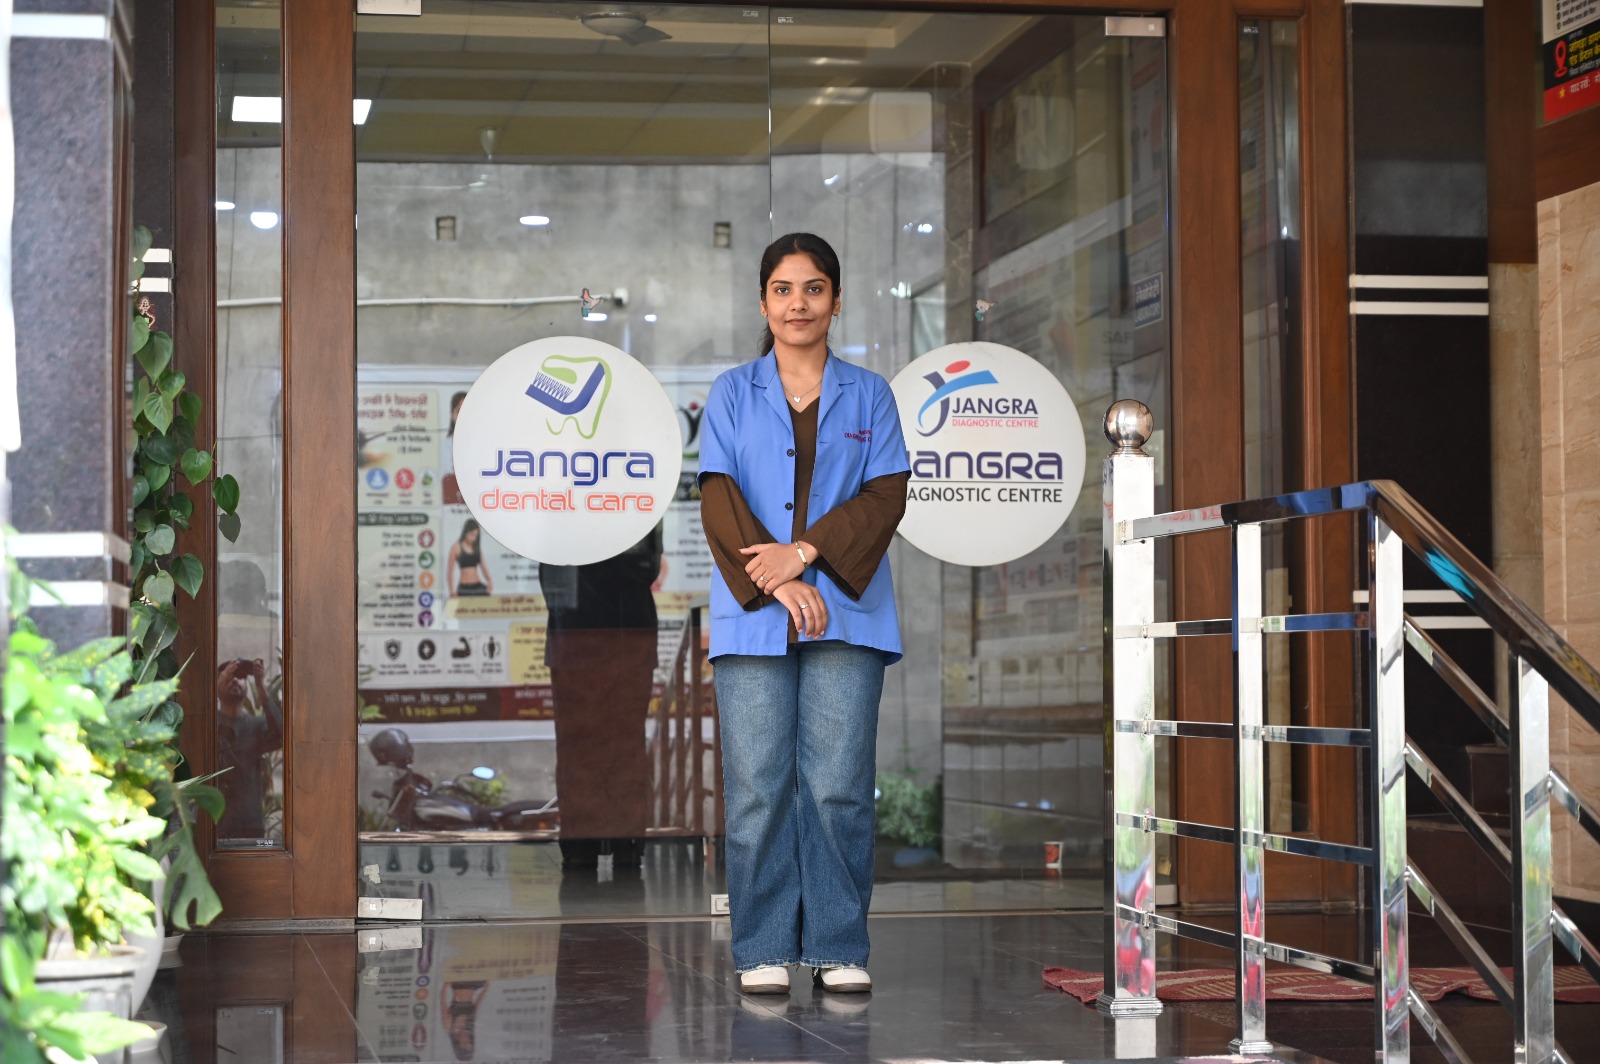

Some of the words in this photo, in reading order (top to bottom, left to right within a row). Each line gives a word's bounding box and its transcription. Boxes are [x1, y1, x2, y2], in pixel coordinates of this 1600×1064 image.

[952, 397, 1038, 415] JANGRA
[952, 418, 1003, 427] DIAGNOSTIC
[1006, 419, 1039, 428] CENTRE
[480, 449, 655, 486] Jangra
[480, 488, 576, 511] dental
[585, 492, 655, 511] care
[907, 486, 991, 502] AGNOSTIC
[997, 487, 1063, 503] CENTRE
